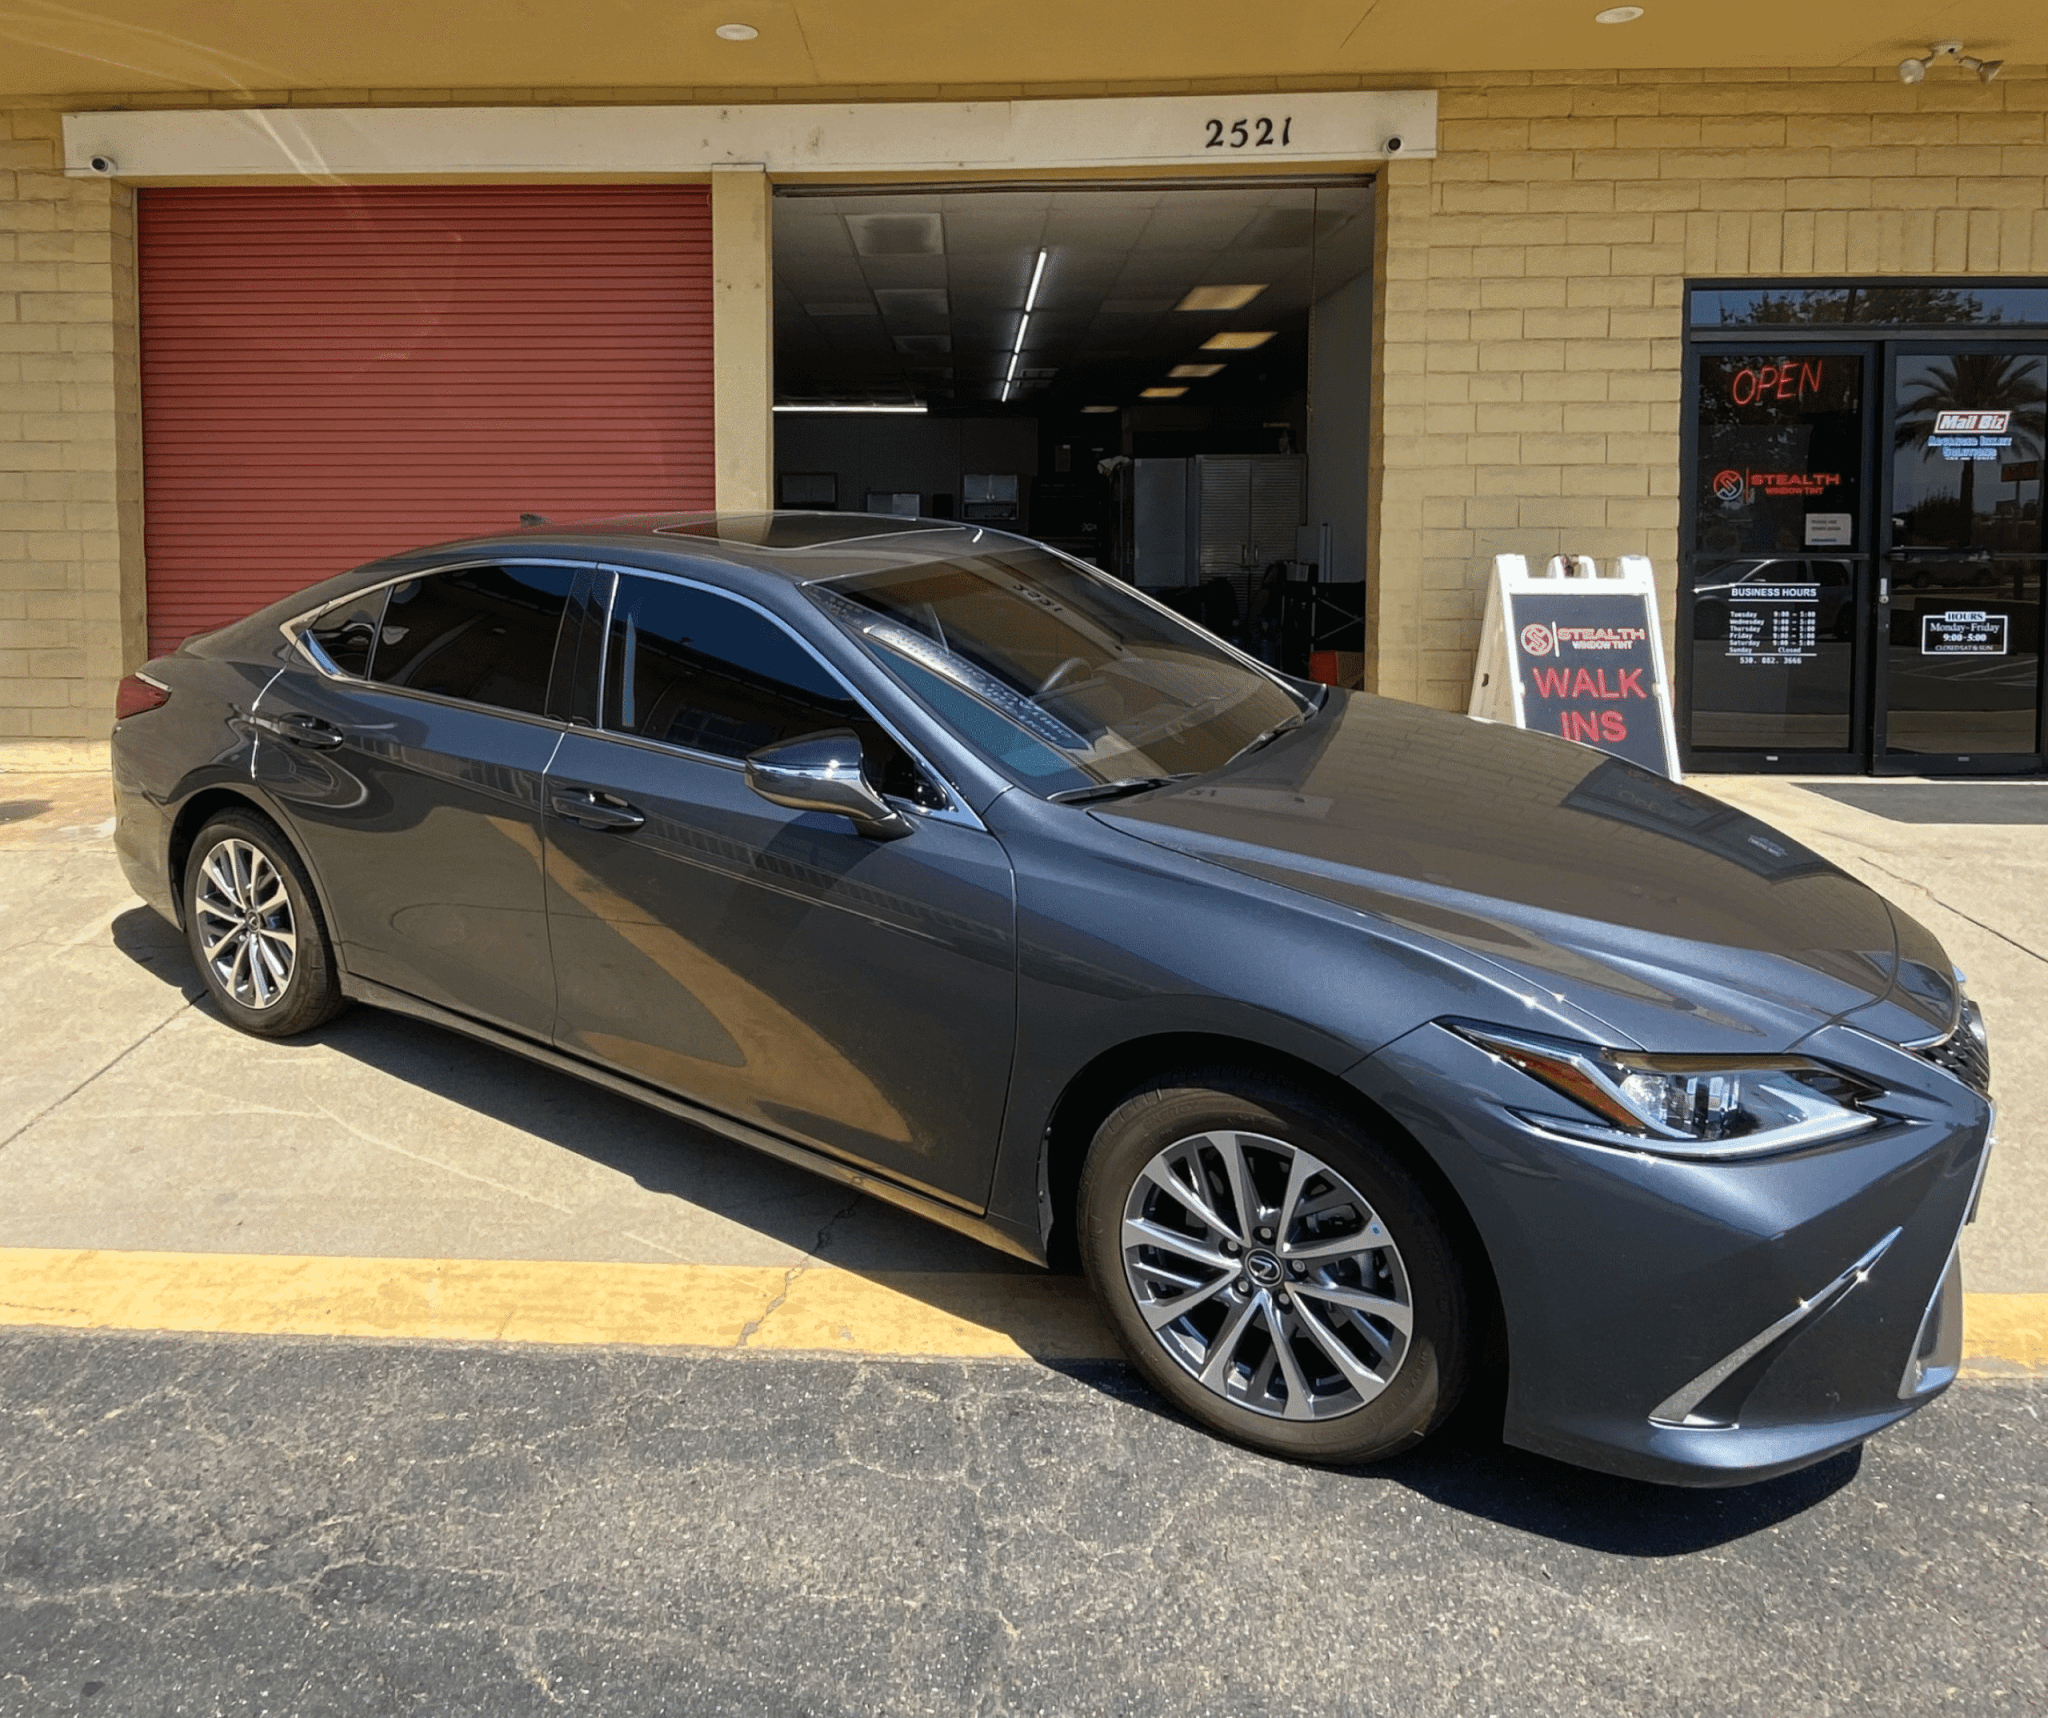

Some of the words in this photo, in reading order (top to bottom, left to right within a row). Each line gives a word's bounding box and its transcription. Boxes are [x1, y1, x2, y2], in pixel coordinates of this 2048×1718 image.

[1205, 116, 1292, 149] 2521
[1732, 360, 1823, 405] OPEN
[1751, 474, 1841, 485] STEALTH
[1765, 487, 1803, 495] WINDOW
[1804, 487, 1824, 495] TINT
[1731, 588, 1780, 596] BUSINESS
[1782, 588, 1816, 596] HOURS
[1730, 611, 1758, 619] Tuesday
[1557, 628, 1646, 641] STEALTH
[1572, 640, 1611, 650] WINDOW
[1612, 640, 1633, 650] TINT
[1532, 667, 1647, 699] WALK
[1560, 710, 1627, 743] INS
